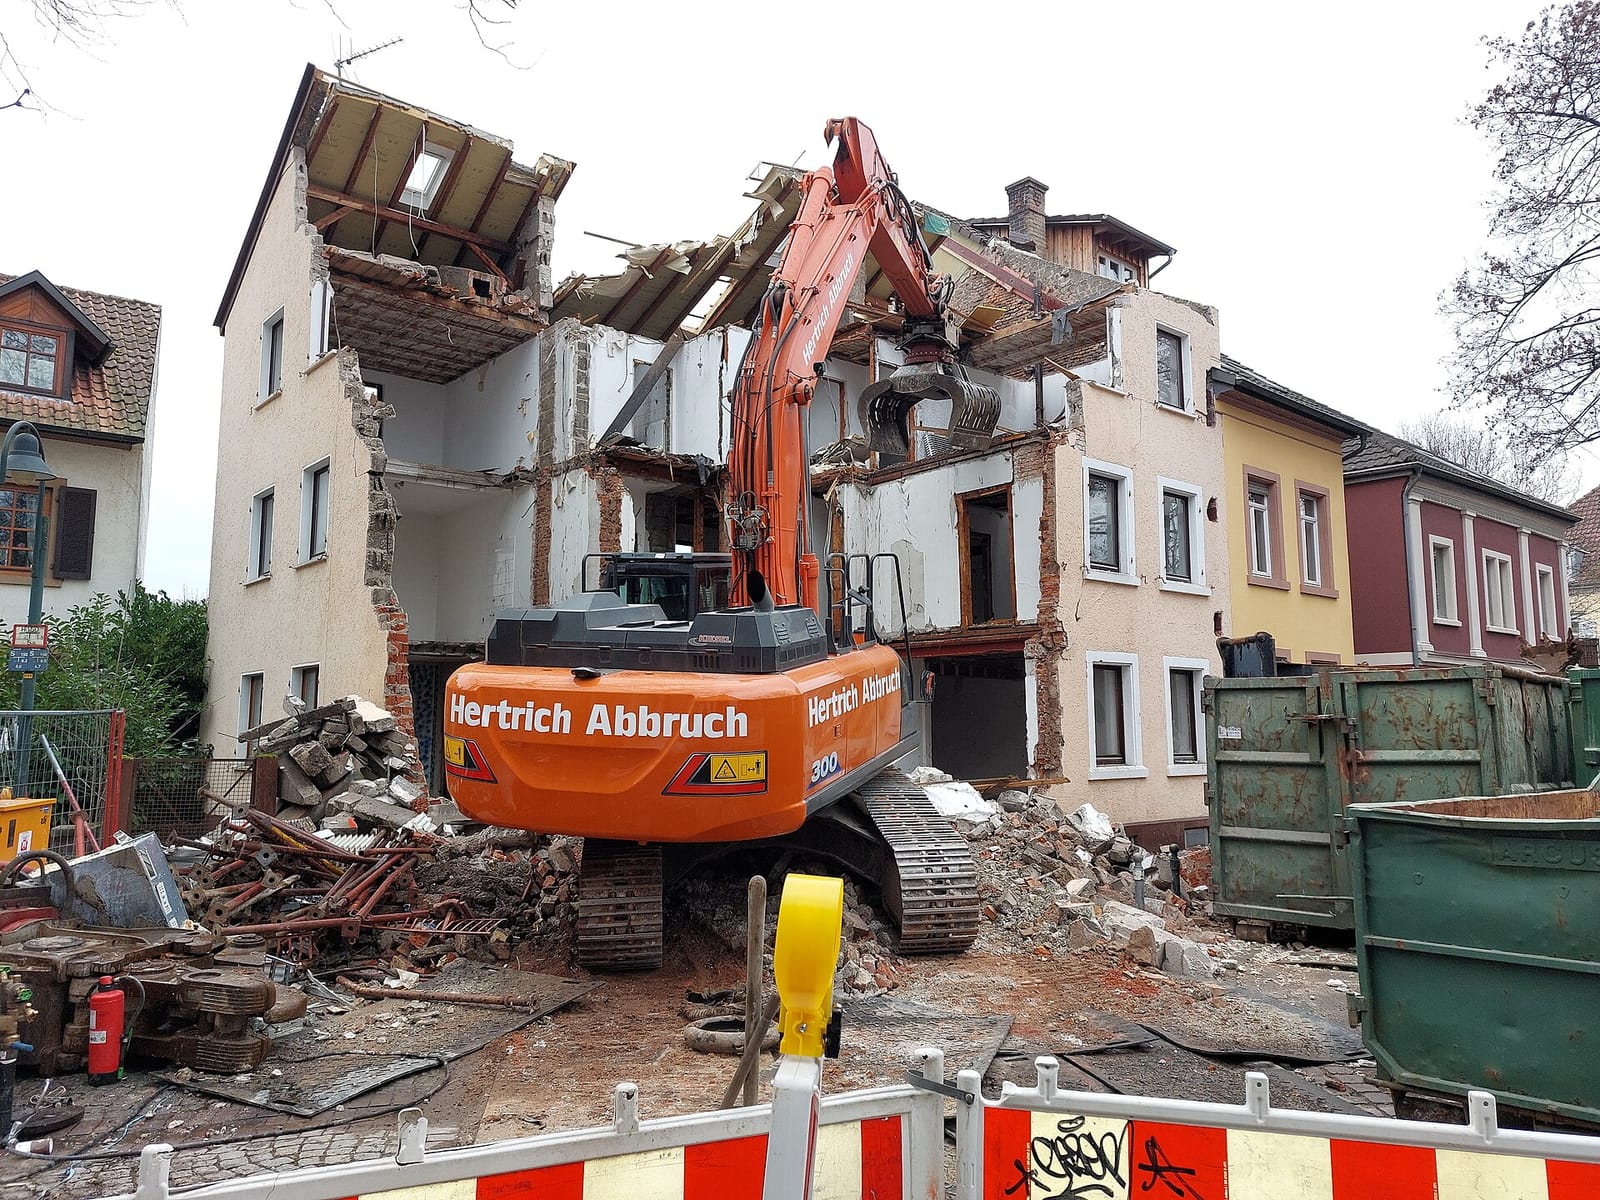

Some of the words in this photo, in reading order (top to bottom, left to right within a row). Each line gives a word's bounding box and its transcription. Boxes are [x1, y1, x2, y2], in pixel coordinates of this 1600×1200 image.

[803, 304, 830, 366] Hertrich
[828, 252, 854, 309] Abbruch
[450, 693, 571, 734] Hertrich
[585, 703, 748, 738] Abbruch
[808, 683, 858, 728] Hertrich
[862, 667, 900, 704] Abbruch
[811, 751, 838, 783] 300
